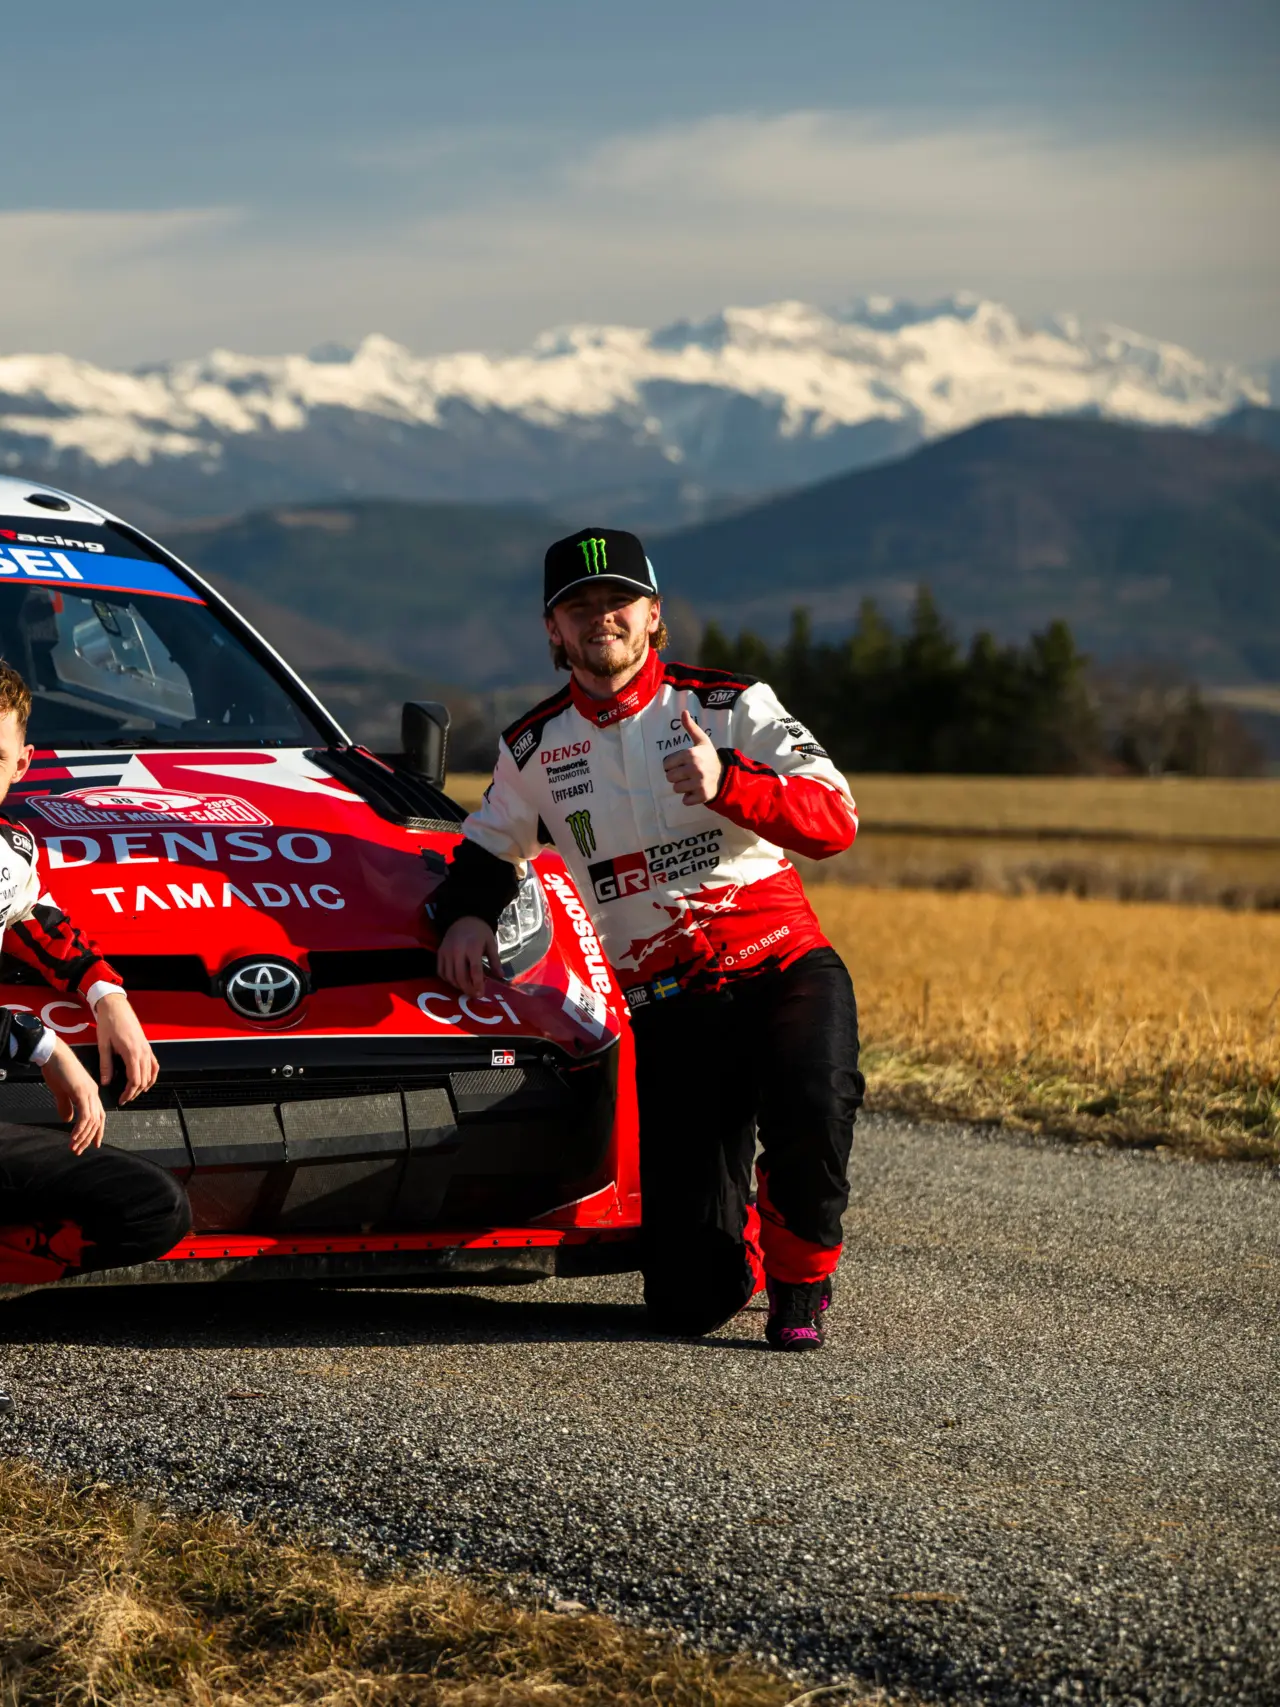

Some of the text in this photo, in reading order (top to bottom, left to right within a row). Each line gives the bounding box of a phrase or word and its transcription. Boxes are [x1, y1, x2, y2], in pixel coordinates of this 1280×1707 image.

[708, 692, 735, 703] OMP
[598, 708, 618, 722] GR
[513, 733, 534, 758] OMP
[541, 740, 591, 765] DENSO
[546, 758, 588, 776] Panasonic
[548, 766, 591, 784] AUTOMOTIVE
[41, 799, 237, 811] 2026 2026
[48, 807, 259, 824] RALLYE MONTE-CARLO
[41, 831, 332, 869] DENSO
[645, 828, 723, 859] TOYOTA
[649, 842, 720, 873] GAZOO
[652, 856, 720, 885] Racing
[594, 868, 647, 901] GR
[91, 882, 346, 913] TAMADIC
[725, 925, 790, 966] O. SOLBERG
[628, 989, 647, 1006] OMP
